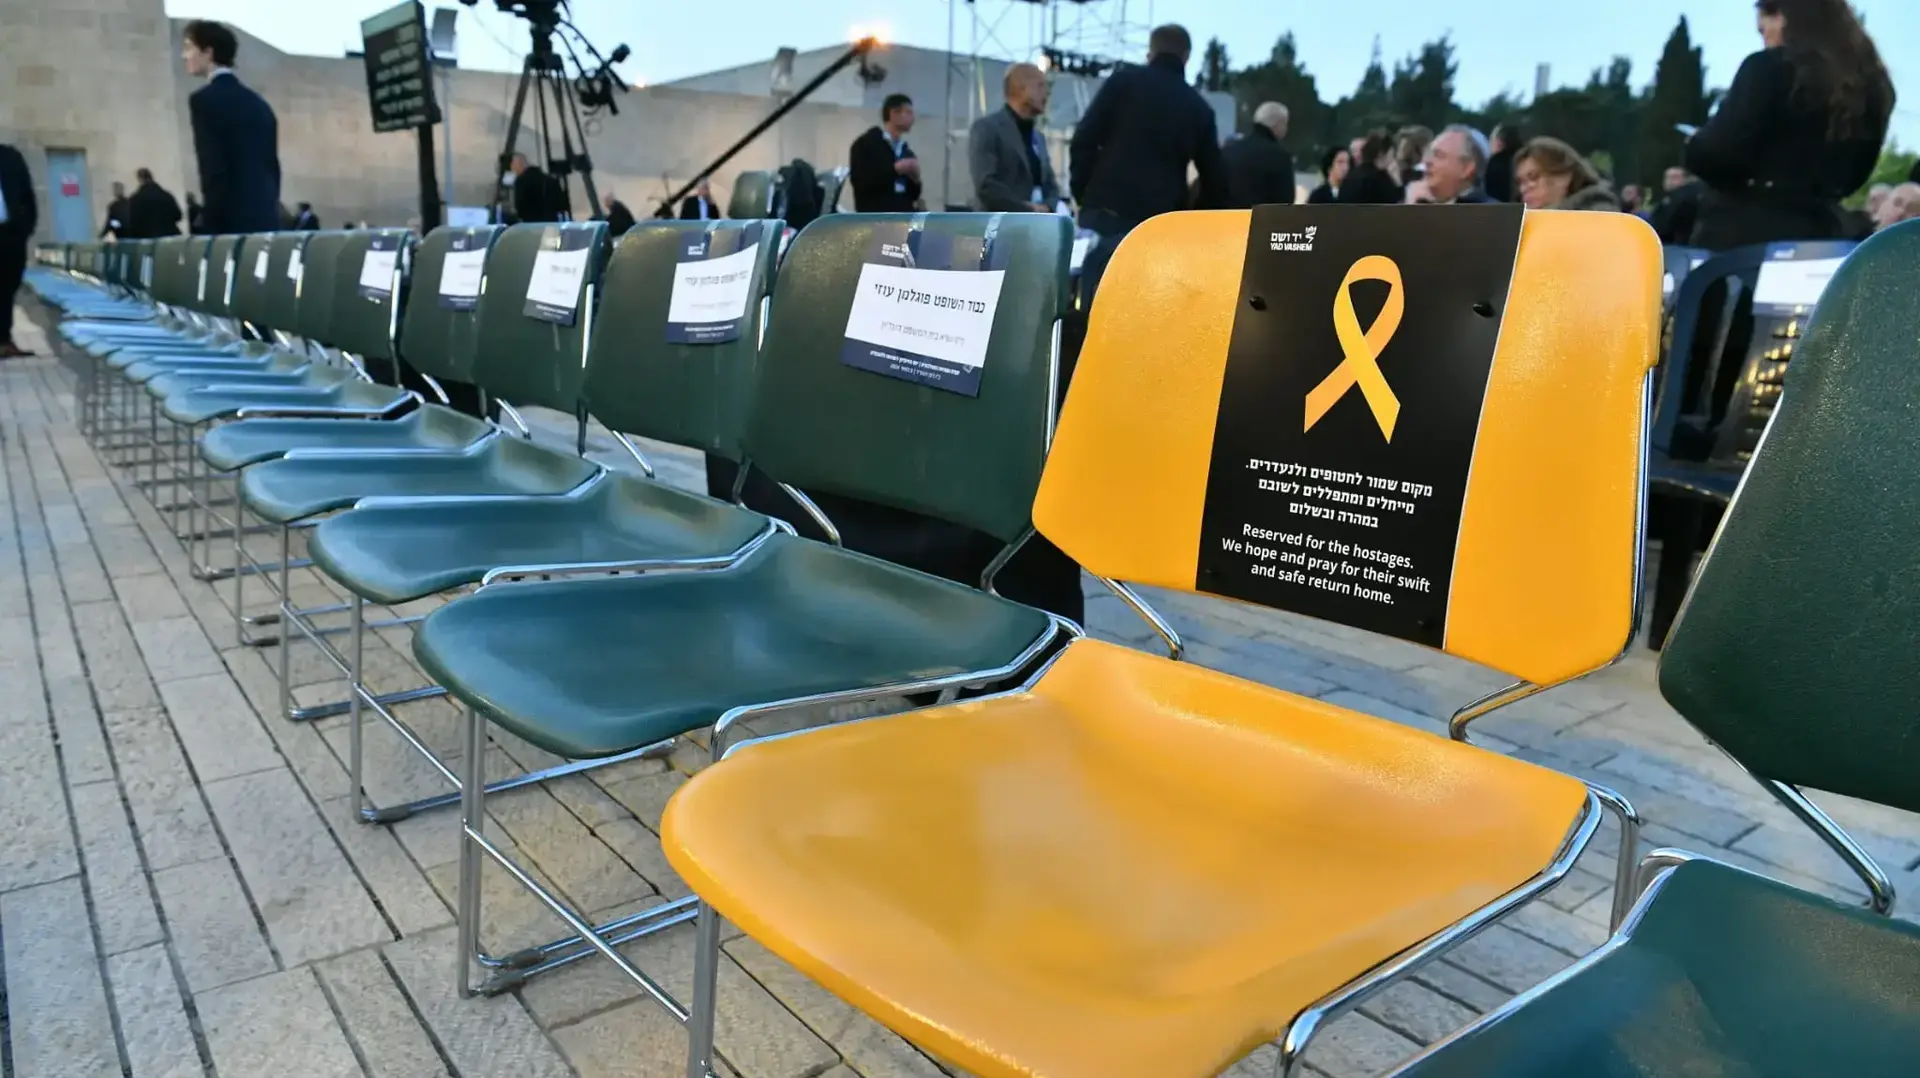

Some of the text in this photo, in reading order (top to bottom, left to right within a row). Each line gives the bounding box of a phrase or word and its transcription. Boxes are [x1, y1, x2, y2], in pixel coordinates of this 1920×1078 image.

[1270, 243, 1312, 251] YAD VASHEM
[1271, 232, 1302, 242] יד ושם
[875, 283, 986, 313] כבוד השופט פוגלמן עוזי
[1245, 458, 1433, 499] מקום שמור לחטופים ולנעדרים.
[1258, 478, 1415, 514] מייחלים ומתפללים לשובם
[1289, 502, 1379, 528] במהרה ובשלום
[1243, 523, 1414, 569] Reserved for the hostages.
[1222, 537, 1431, 593] We hope and pray for their swift
[1251, 563, 1395, 605] and safe return home.
